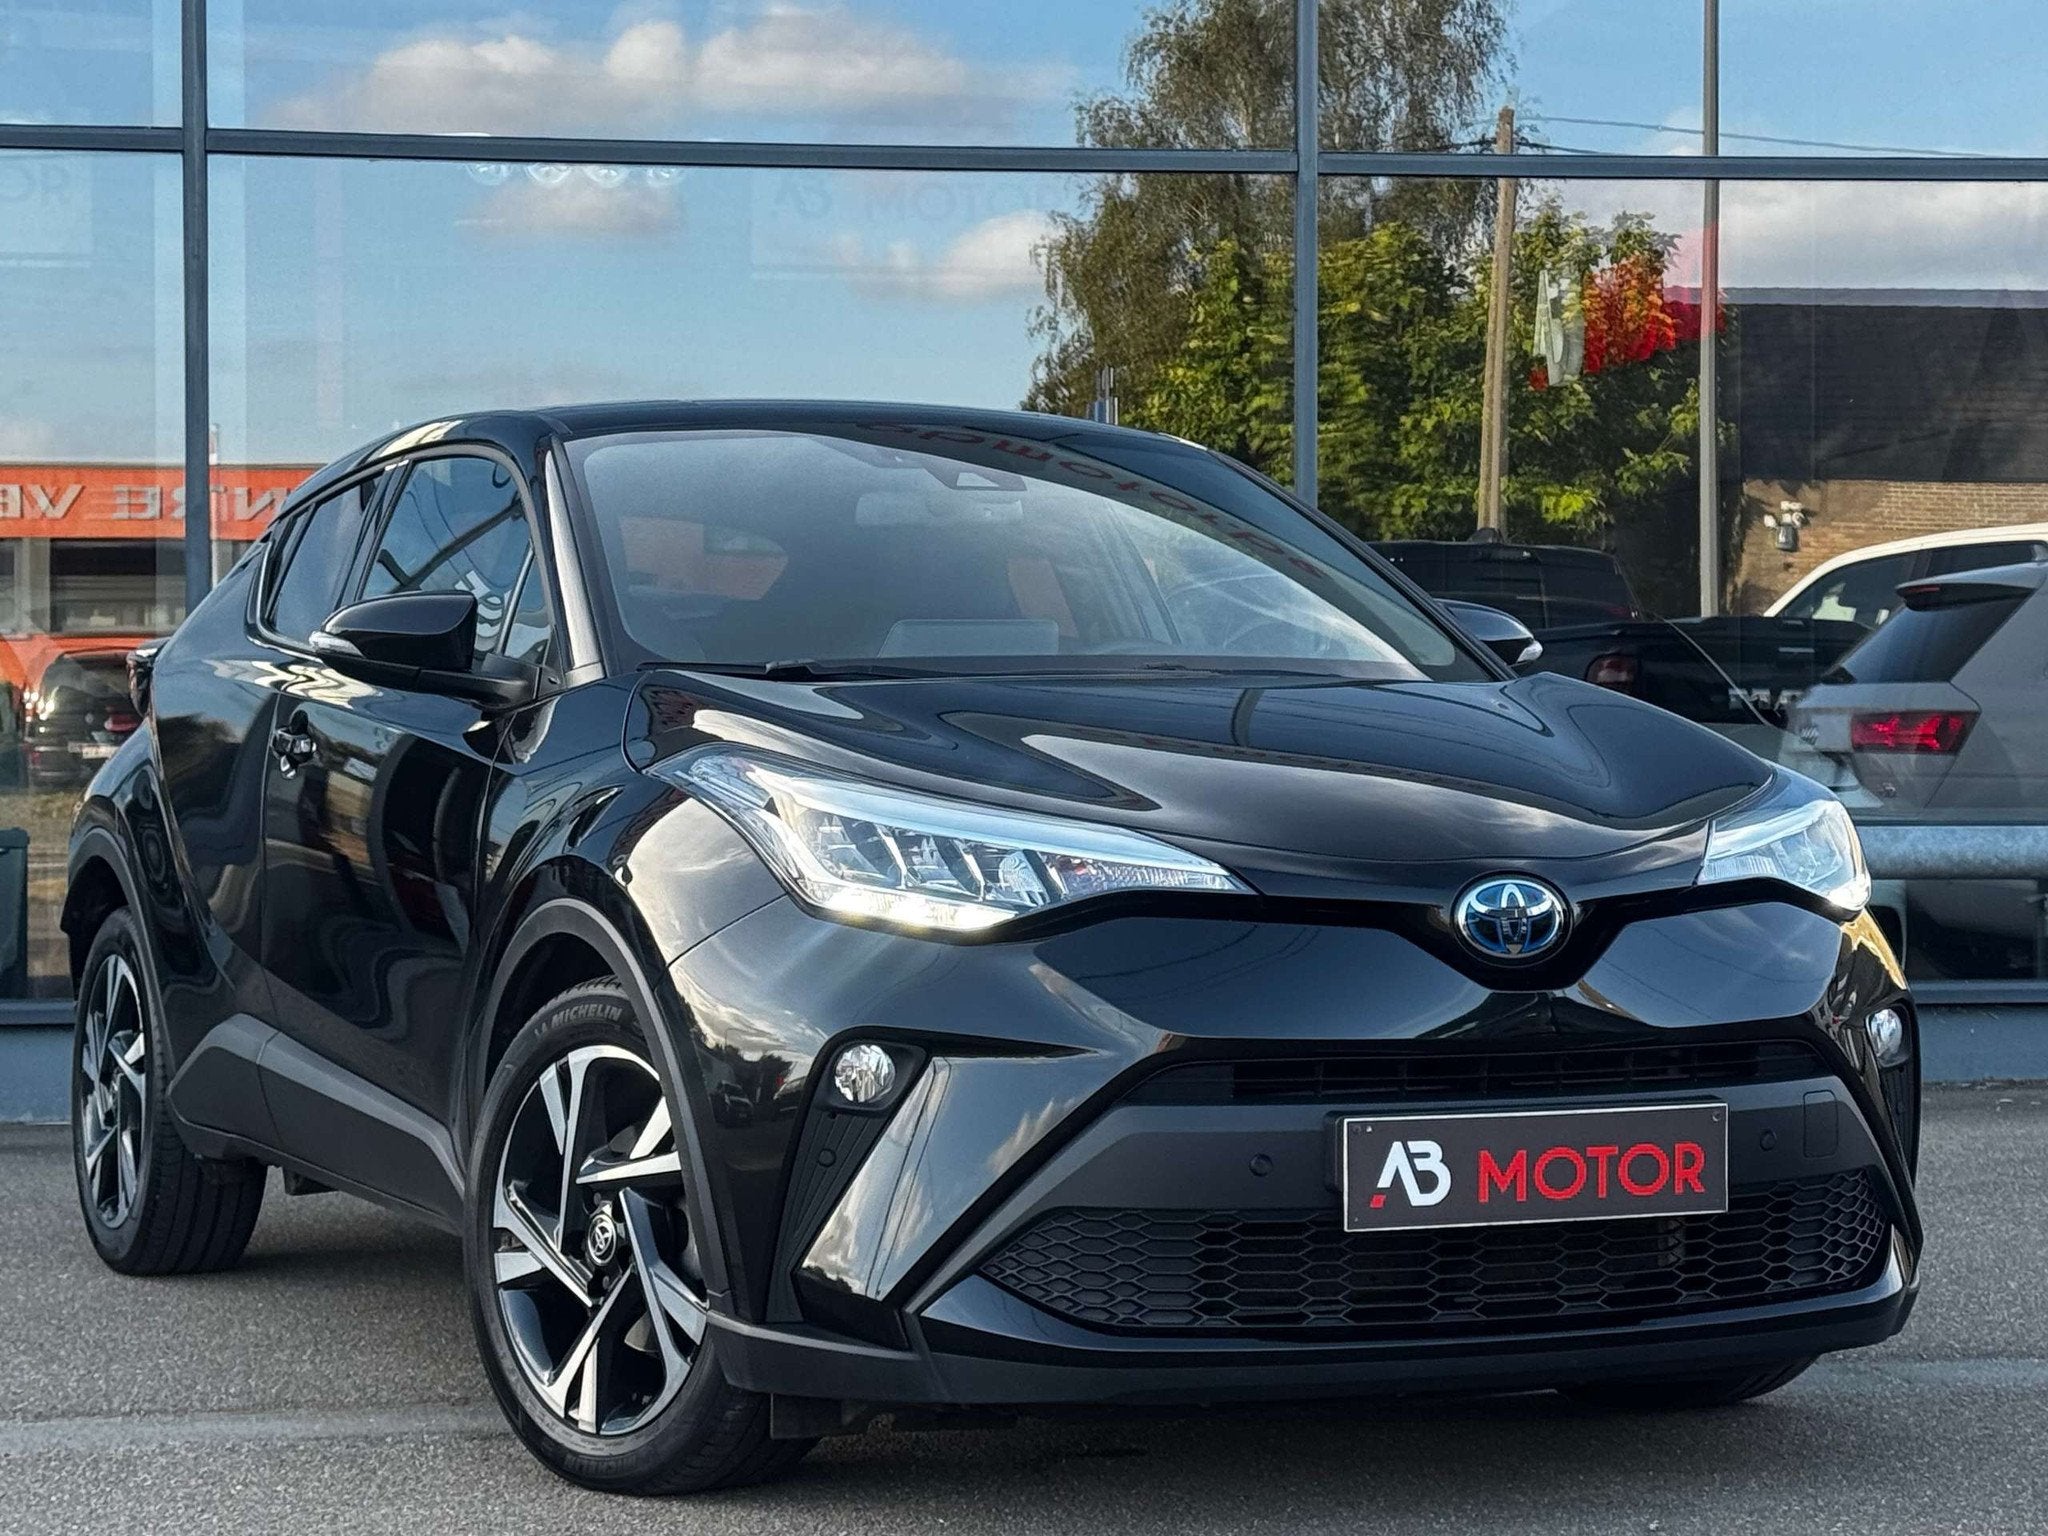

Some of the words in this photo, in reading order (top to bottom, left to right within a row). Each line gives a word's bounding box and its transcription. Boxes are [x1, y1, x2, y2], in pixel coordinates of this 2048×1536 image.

[551, 1004, 623, 1028] MICHELIN
[1369, 1140, 1451, 1208] AB
[1477, 1141, 1706, 1203] MOTOR
